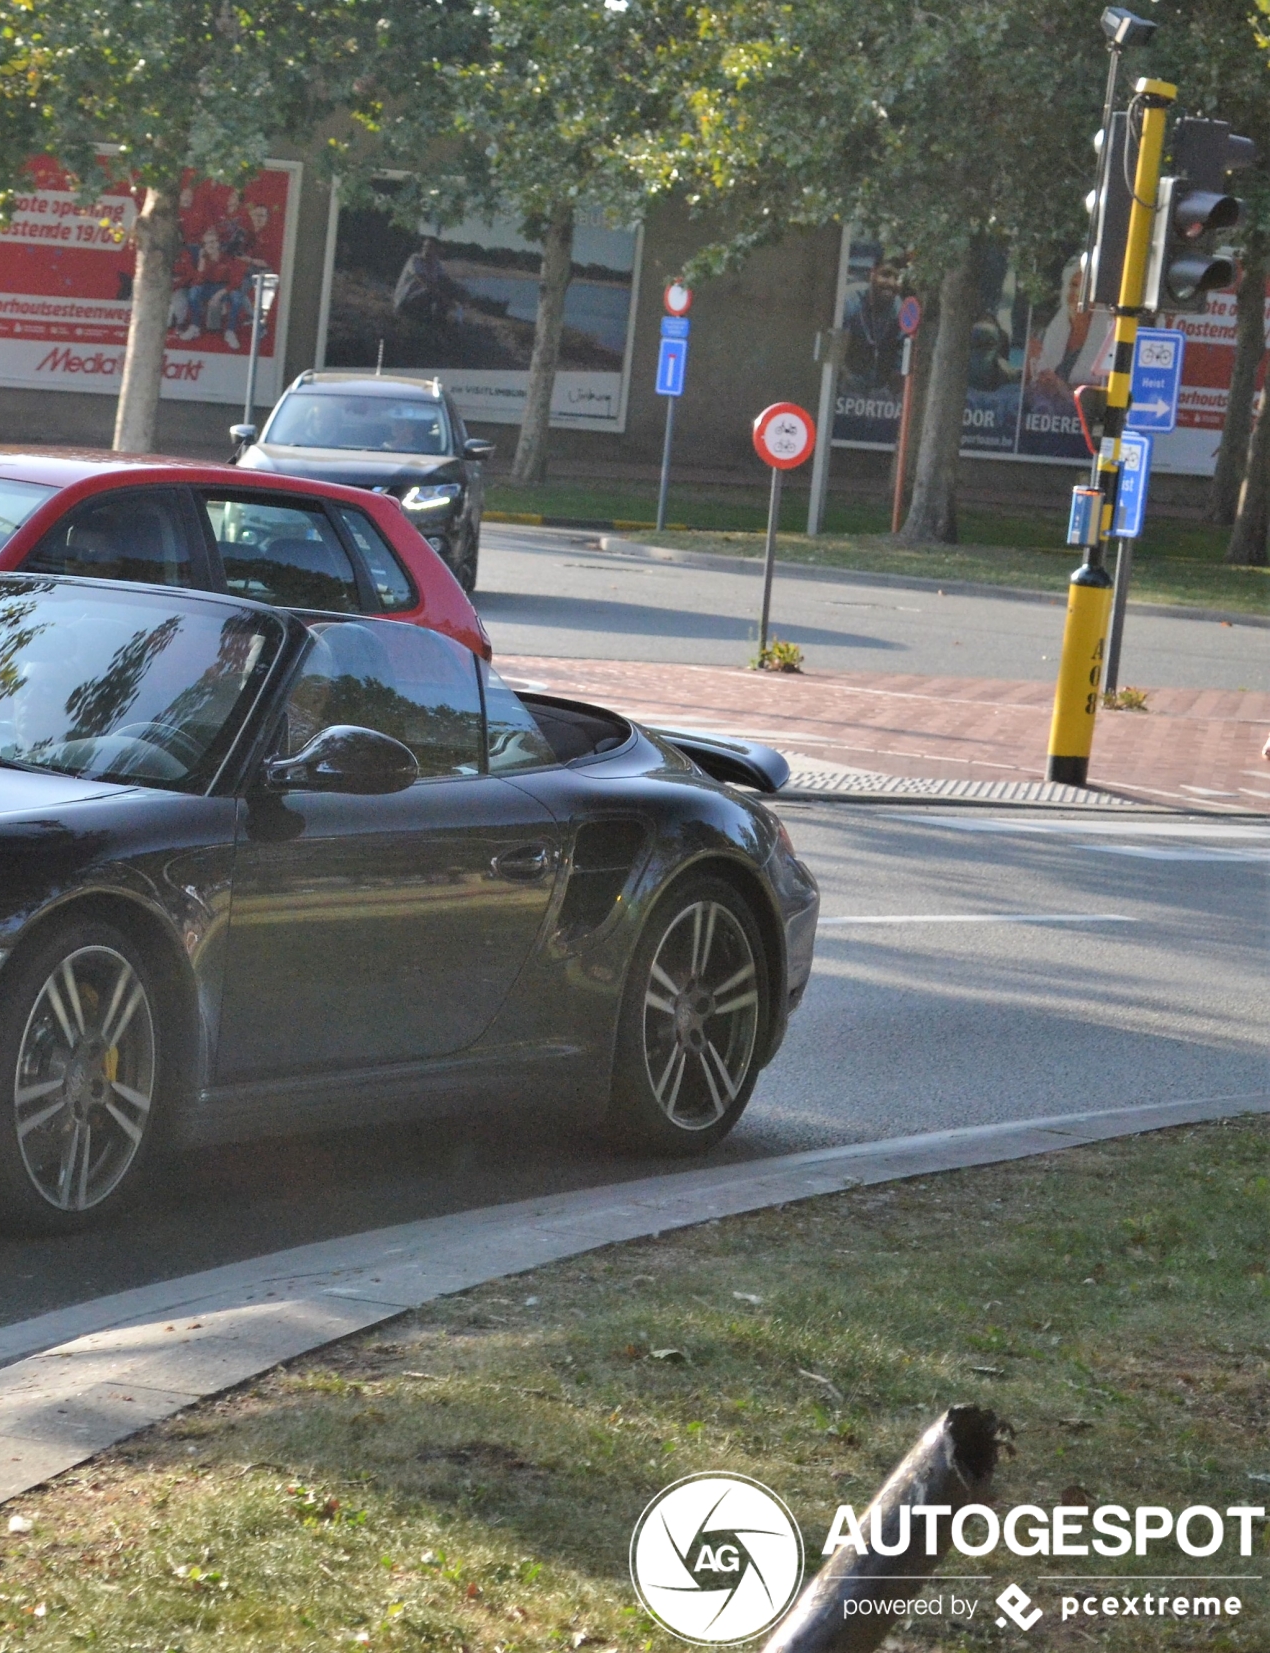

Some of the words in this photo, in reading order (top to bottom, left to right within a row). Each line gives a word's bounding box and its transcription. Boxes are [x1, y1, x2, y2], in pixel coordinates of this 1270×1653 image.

[161, 353, 205, 381] arkt
[1142, 376, 1165, 389] Heist
[1025, 413, 1085, 435] IEDERE
